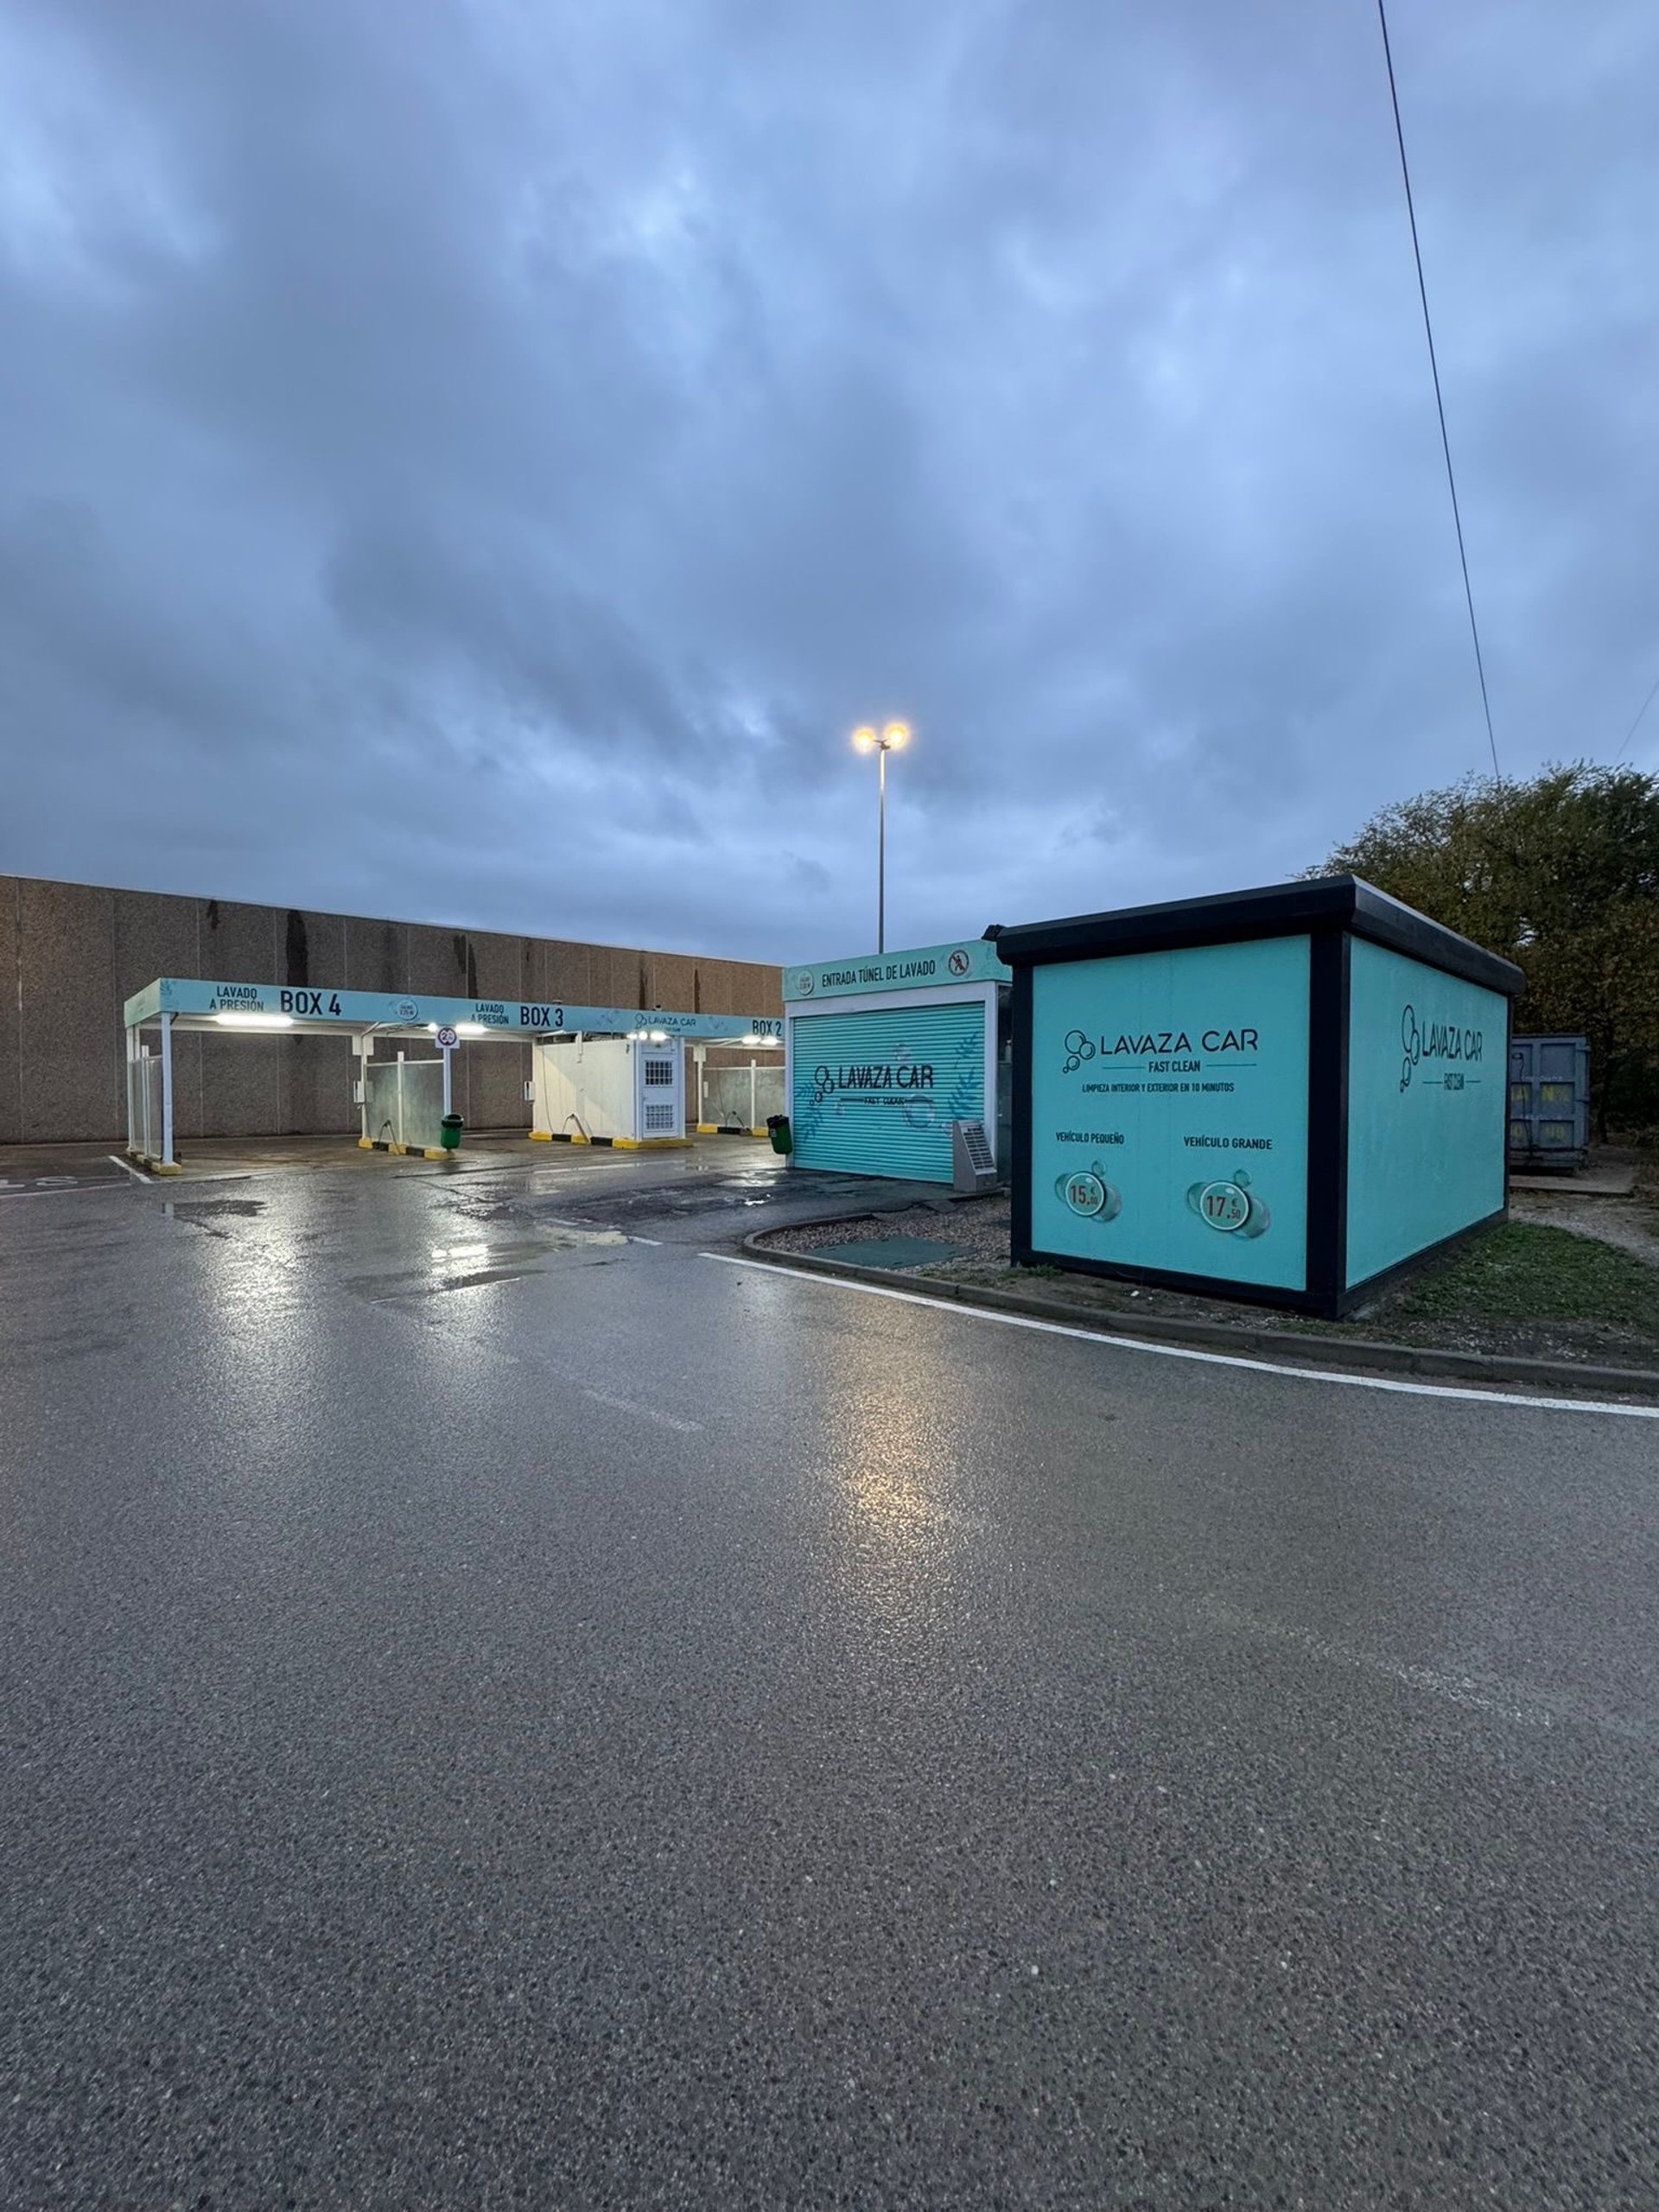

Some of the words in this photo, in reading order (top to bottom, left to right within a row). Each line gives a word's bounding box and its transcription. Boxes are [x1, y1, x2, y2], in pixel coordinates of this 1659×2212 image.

[822, 971, 857, 988] ENTRADA
[858, 965, 884, 983] TÚNEL
[886, 965, 898, 980] DE
[899, 959, 936, 979] LAVADO
[216, 986, 257, 999] LAVADO
[209, 999, 217, 1010] A
[219, 999, 264, 1012] PRESIÓN
[280, 990, 323, 1014] BOX
[328, 993, 342, 1016] 4
[475, 1003, 505, 1014] LAVADO
[520, 1007, 550, 1027] BOX
[555, 1008, 563, 1027] 3
[649, 1015, 678, 1026] LAVAZA
[680, 1017, 696, 1027] CAR
[752, 1020, 773, 1036] BOX
[775, 1021, 782, 1037] 2
[1101, 1032, 1192, 1056] LAVAZA
[1202, 1028, 1258, 1052] CAR
[1422, 1020, 1462, 1060] LAVAZA
[1464, 1029, 1483, 1062] CAR
[1148, 1061, 1170, 1072] FAST
[1172, 1060, 1201, 1072] CLEAN
[838, 1065, 892, 1090] LAVAZA
[896, 1065, 933, 1089] CAR
[1082, 1084, 1109, 1093] LIMPIEZA
[1111, 1084, 1140, 1093] INTERIOR
[1141, 1084, 1146, 1092] Y
[1147, 1083, 1179, 1093] EXTERIOR
[1180, 1083, 1190, 1092] EN
[1192, 1083, 1200, 1092] 10
[1202, 1082, 1235, 1092] MINUTOS
[1056, 1131, 1089, 1142] VEHÍCULO
[1090, 1132, 1124, 1144] PEQUEÑO
[1184, 1135, 1230, 1148] VEHÍCULO
[1231, 1138, 1273, 1150] GRANDE
